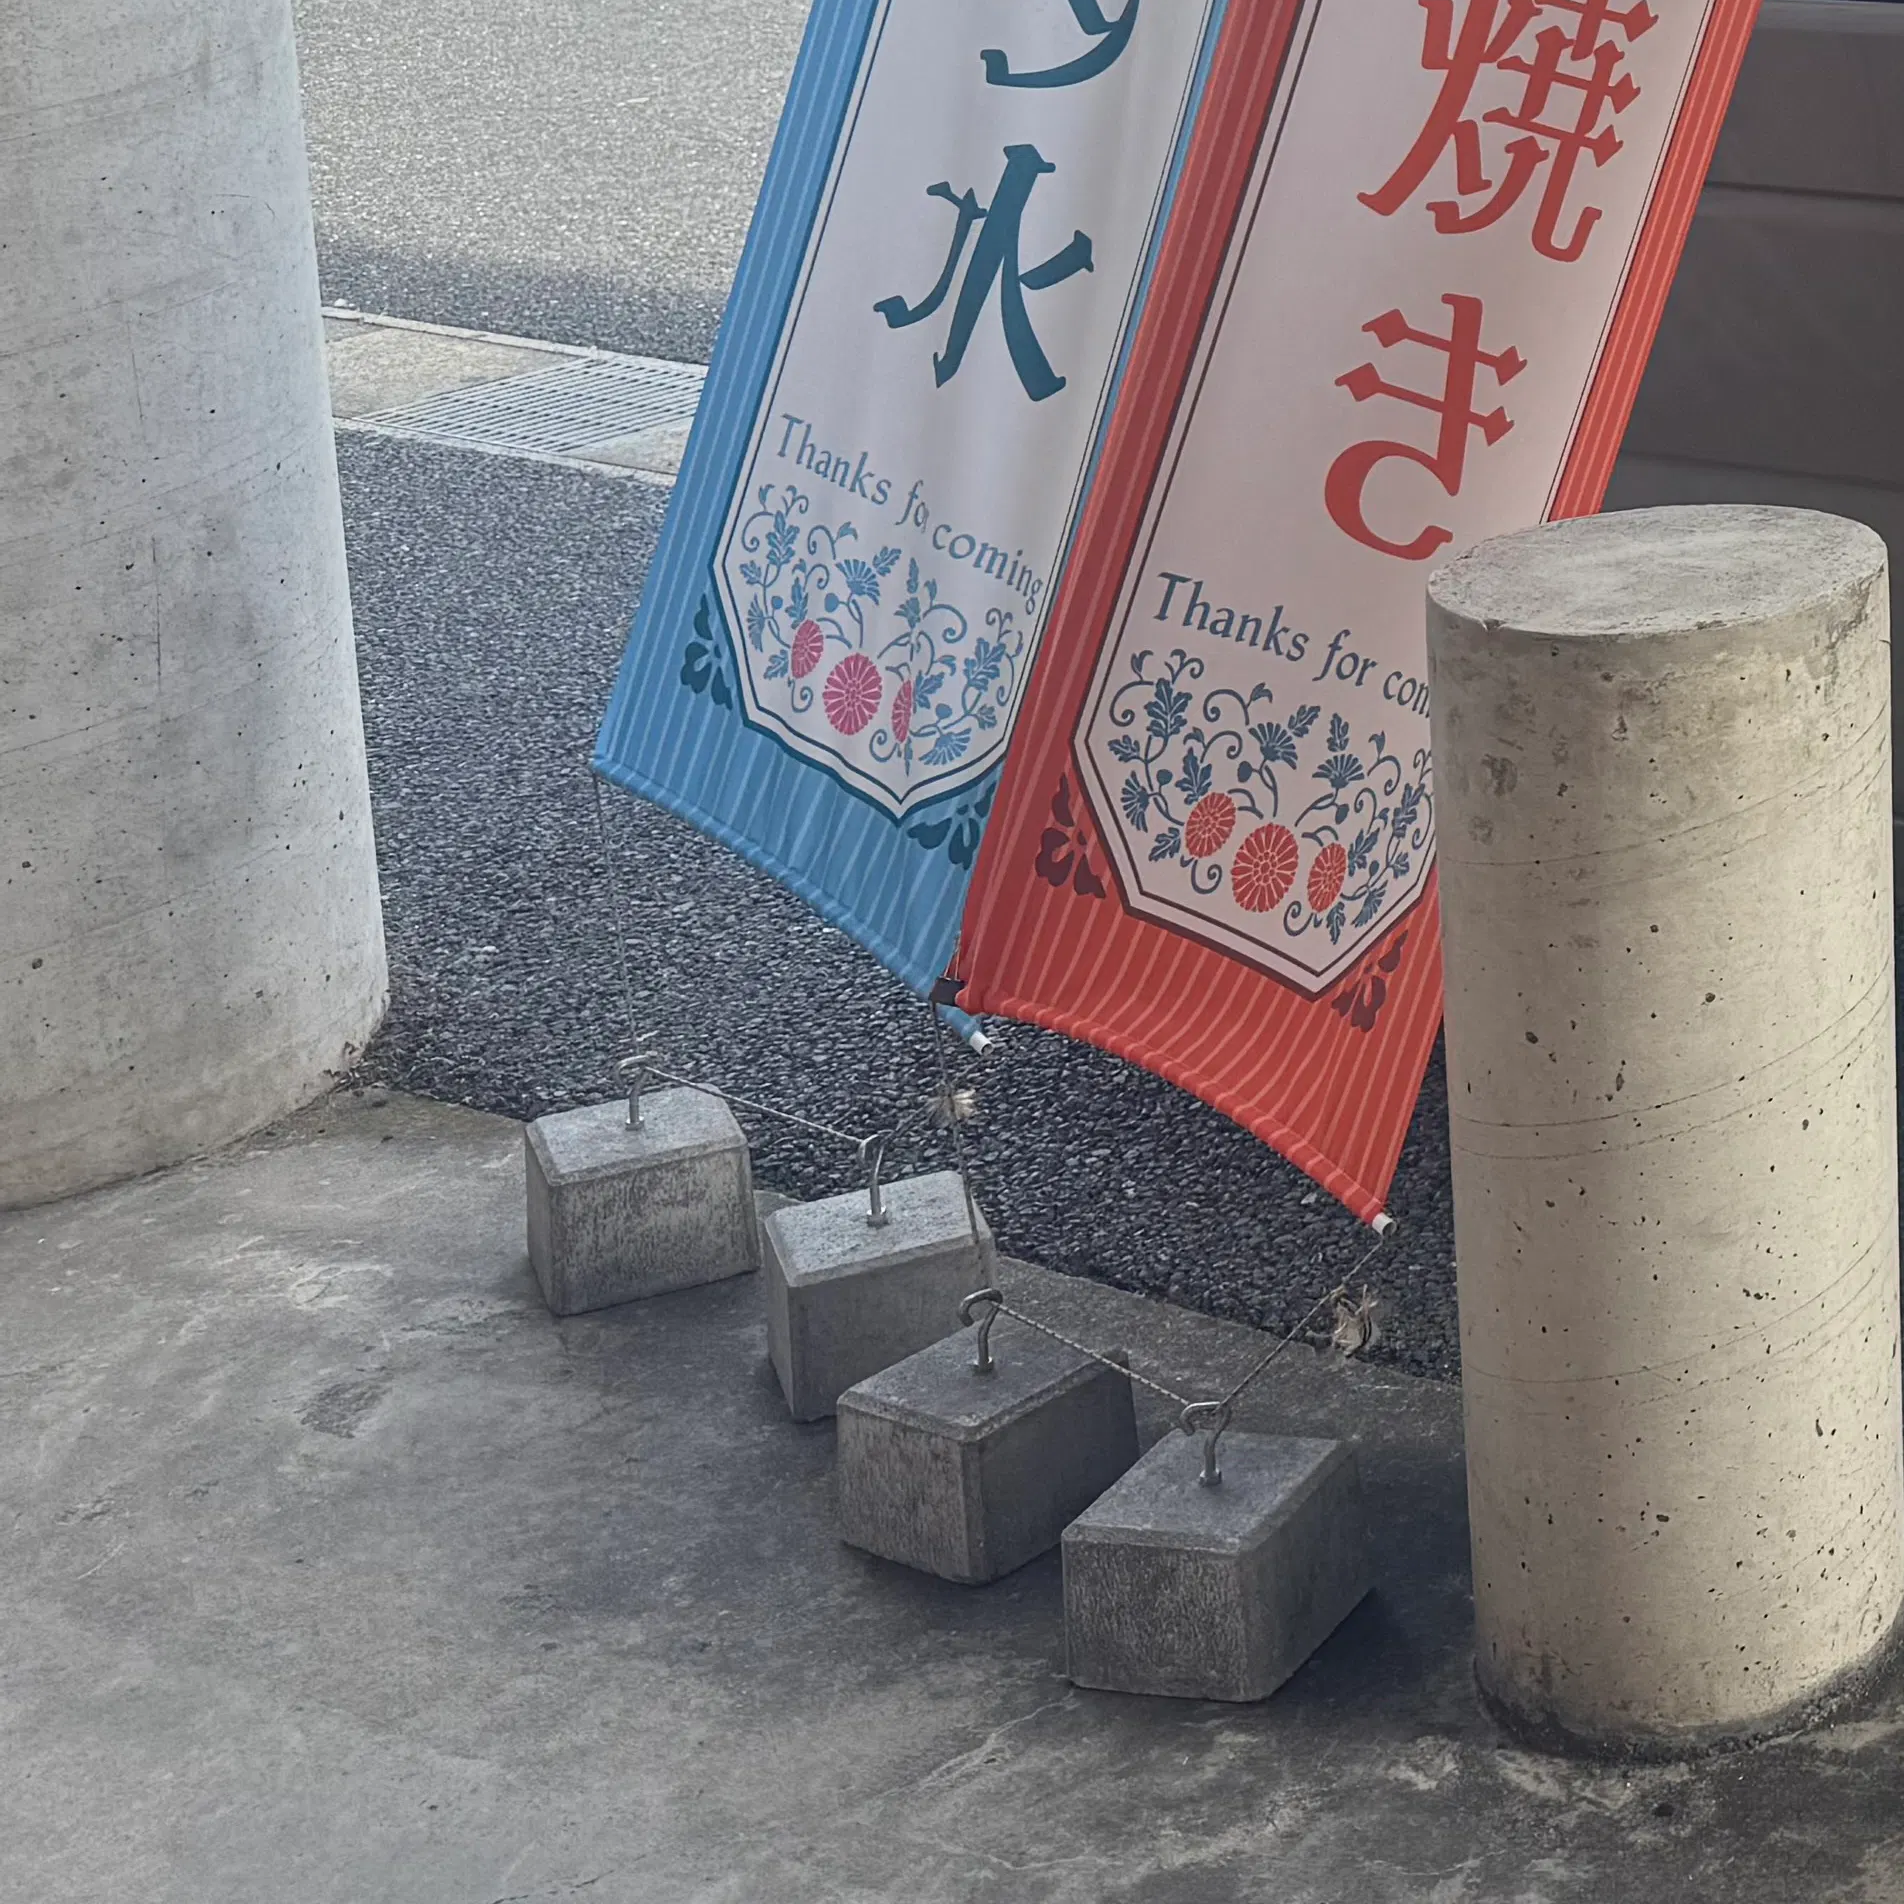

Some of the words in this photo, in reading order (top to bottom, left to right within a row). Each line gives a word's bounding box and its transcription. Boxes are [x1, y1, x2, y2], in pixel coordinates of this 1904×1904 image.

[777, 413, 892, 505] Thanks
[894, 479, 930, 534] fo
[932, 524, 1044, 615] coming
[1154, 572, 1310, 661] Thanks
[1312, 629, 1378, 687] for
